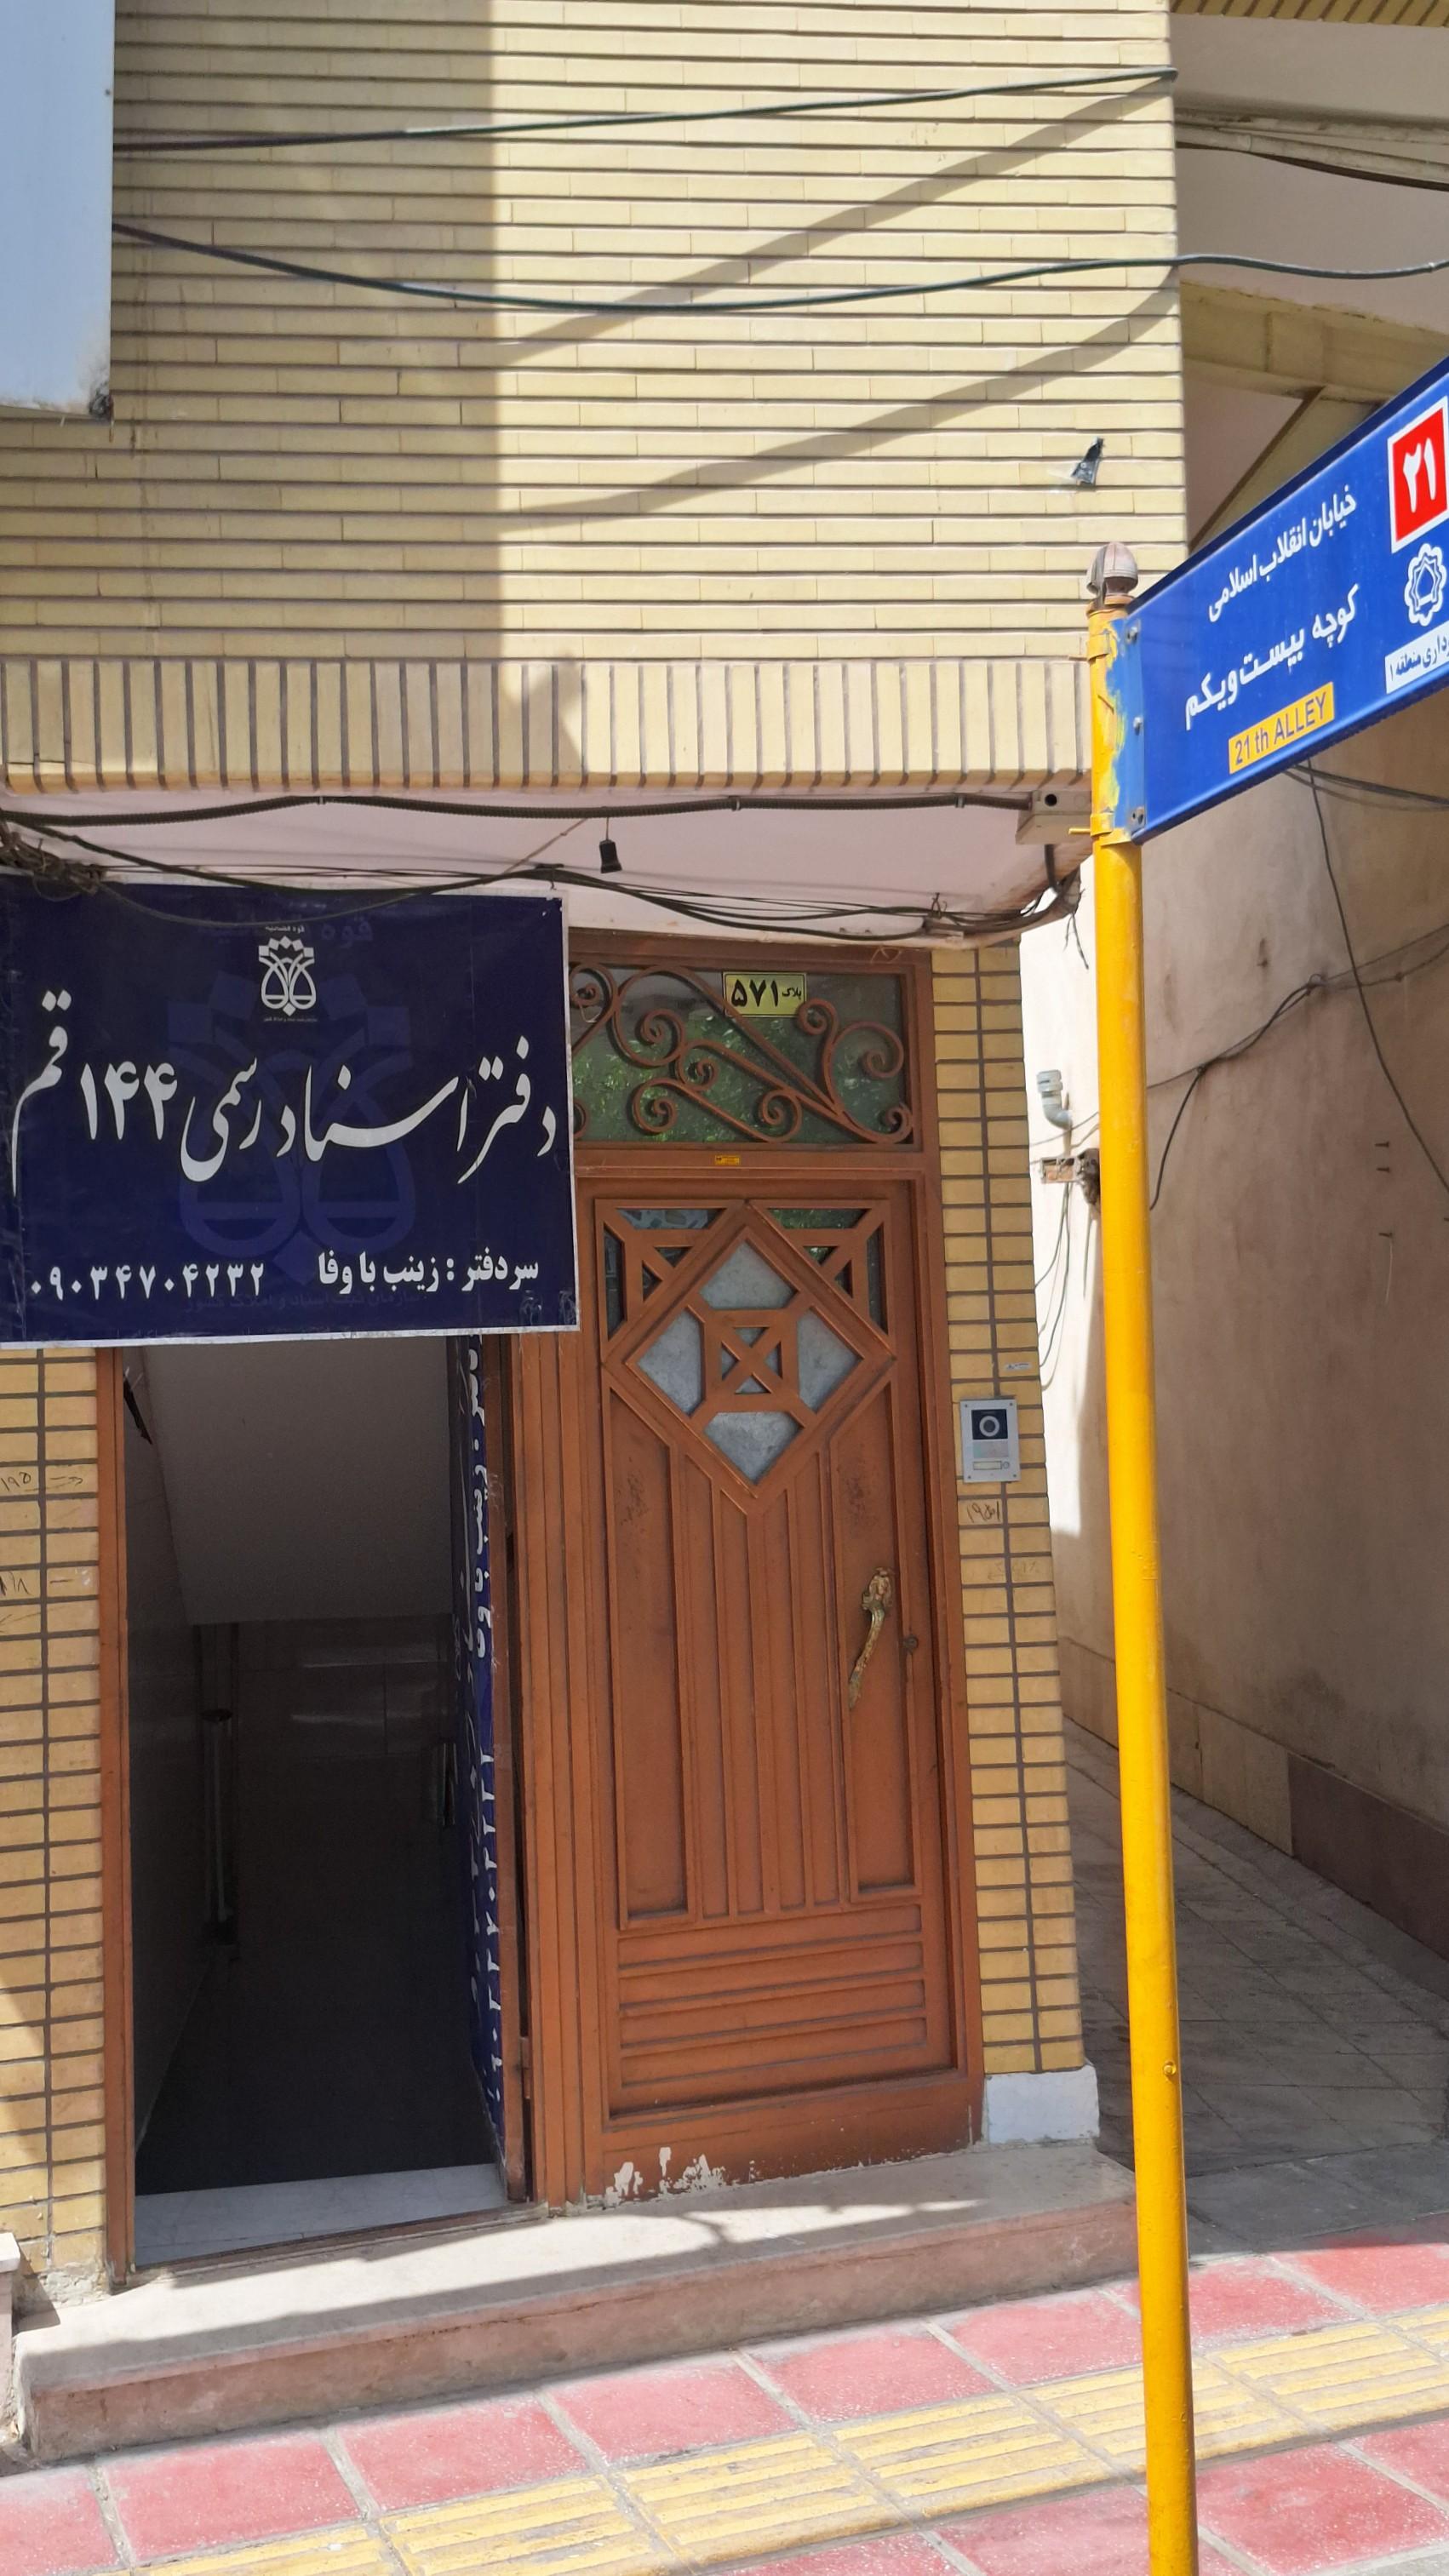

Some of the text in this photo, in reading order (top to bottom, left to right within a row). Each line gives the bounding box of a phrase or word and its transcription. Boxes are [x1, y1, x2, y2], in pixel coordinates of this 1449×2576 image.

[1402, 437, 1437, 514] ۲۱
[1208, 484, 1357, 623] خیابان انقلاب اسلامی
[1312, 583, 1360, 649] کوچه
[1235, 691, 1326, 765] 21 th ALLEY
[730, 978, 802, 1008] ۵۷۱ پلاک
[12, 989, 558, 1198] دفتر اسناد رسمی ۱۴۴ قم
[383, 1253, 440, 1293] زینب
